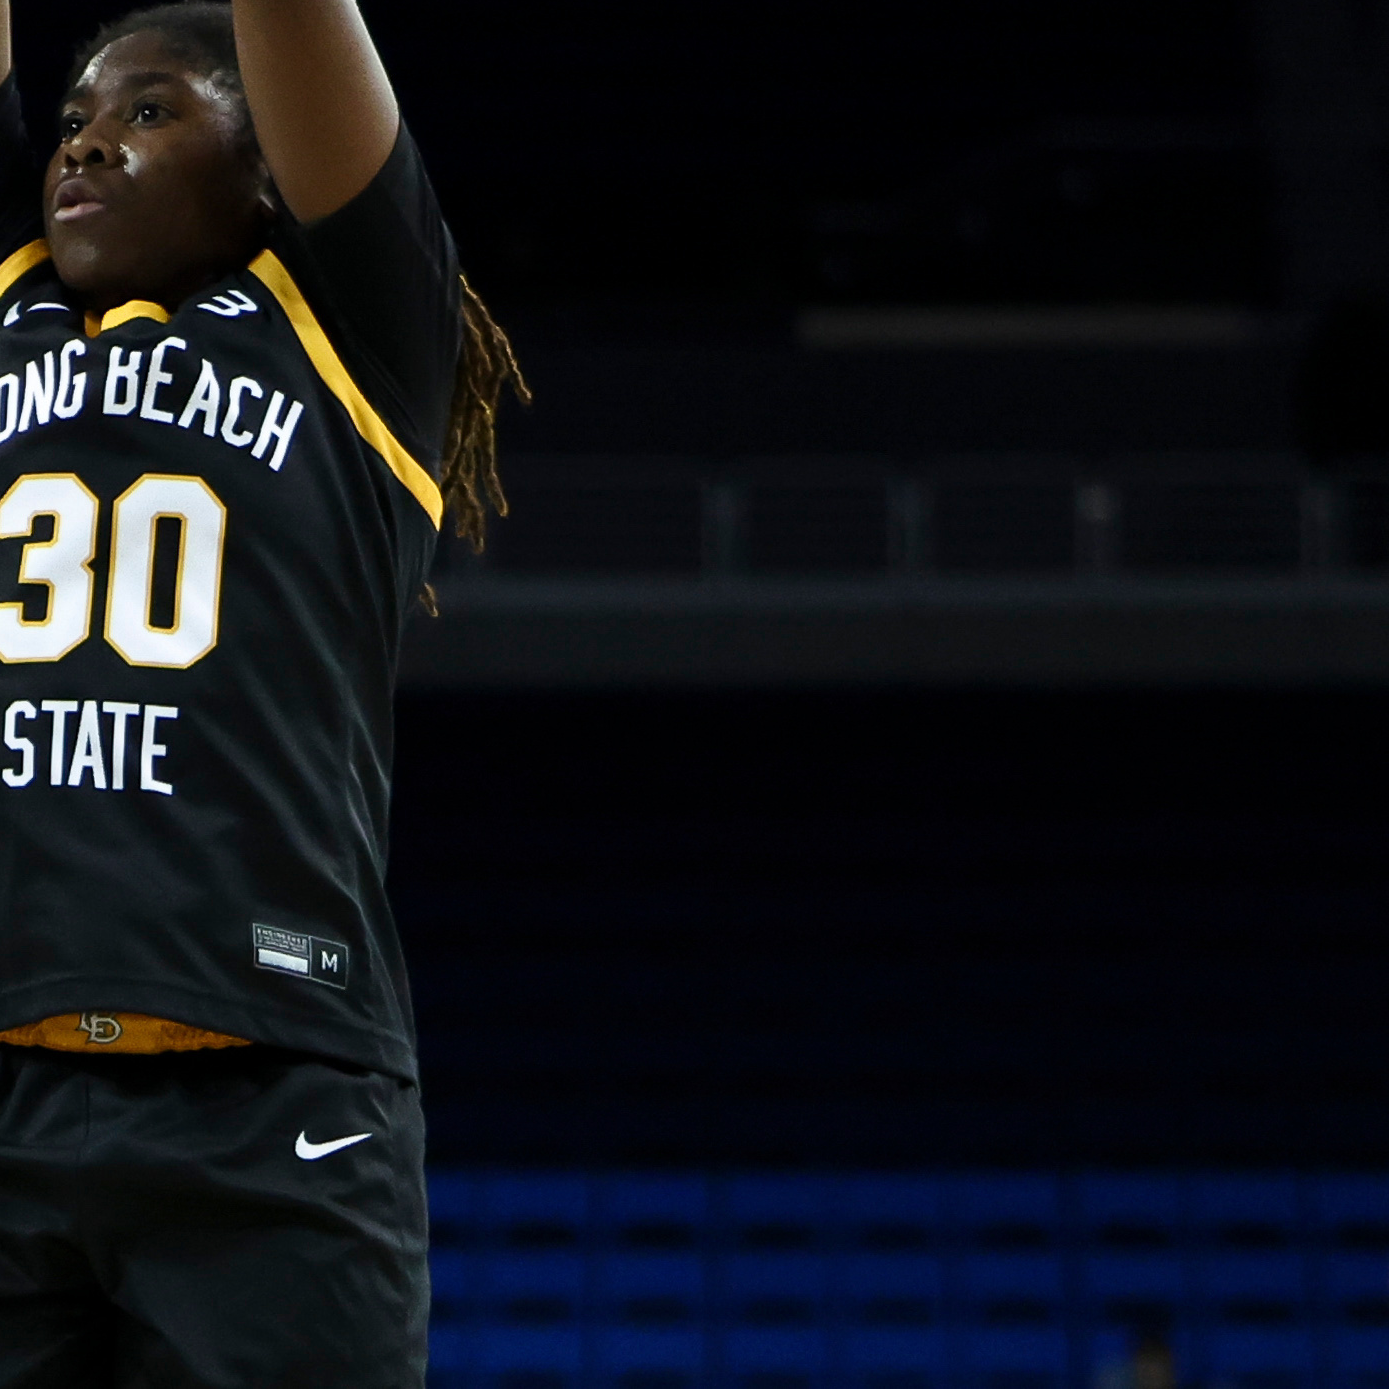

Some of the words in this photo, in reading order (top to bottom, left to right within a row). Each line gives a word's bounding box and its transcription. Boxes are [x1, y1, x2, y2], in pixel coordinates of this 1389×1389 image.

[102, 336, 305, 473] BEACH
[2, 699, 180, 796] STATE
[321, 950, 339, 974] M
